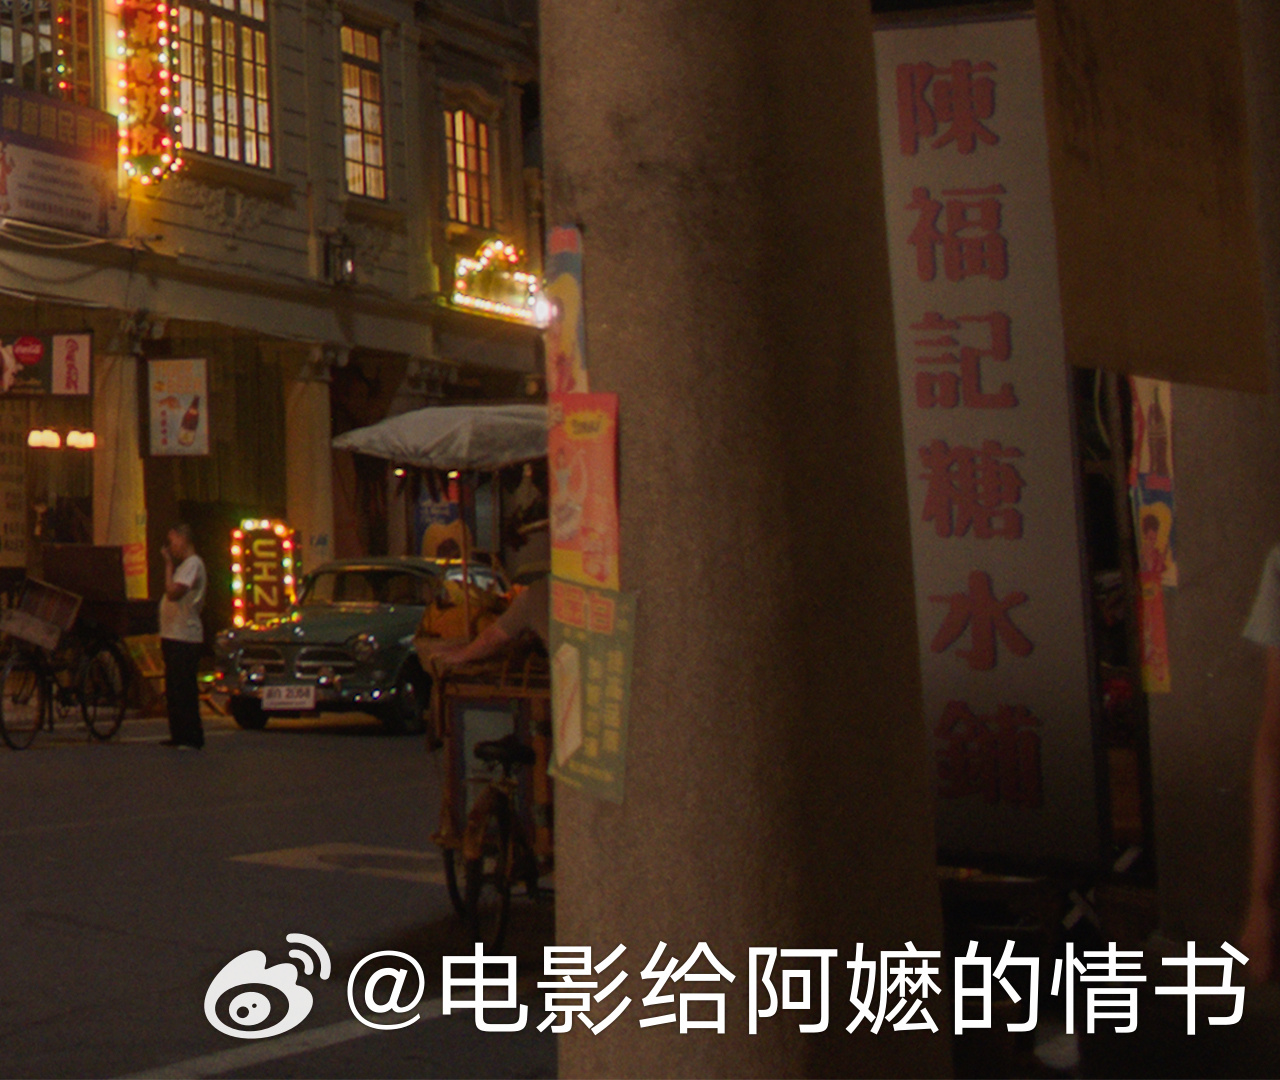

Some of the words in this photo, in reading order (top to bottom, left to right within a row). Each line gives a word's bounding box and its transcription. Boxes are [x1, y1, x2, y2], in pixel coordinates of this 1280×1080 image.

[894, 58, 1047, 811] 陳福記糖水鋪
